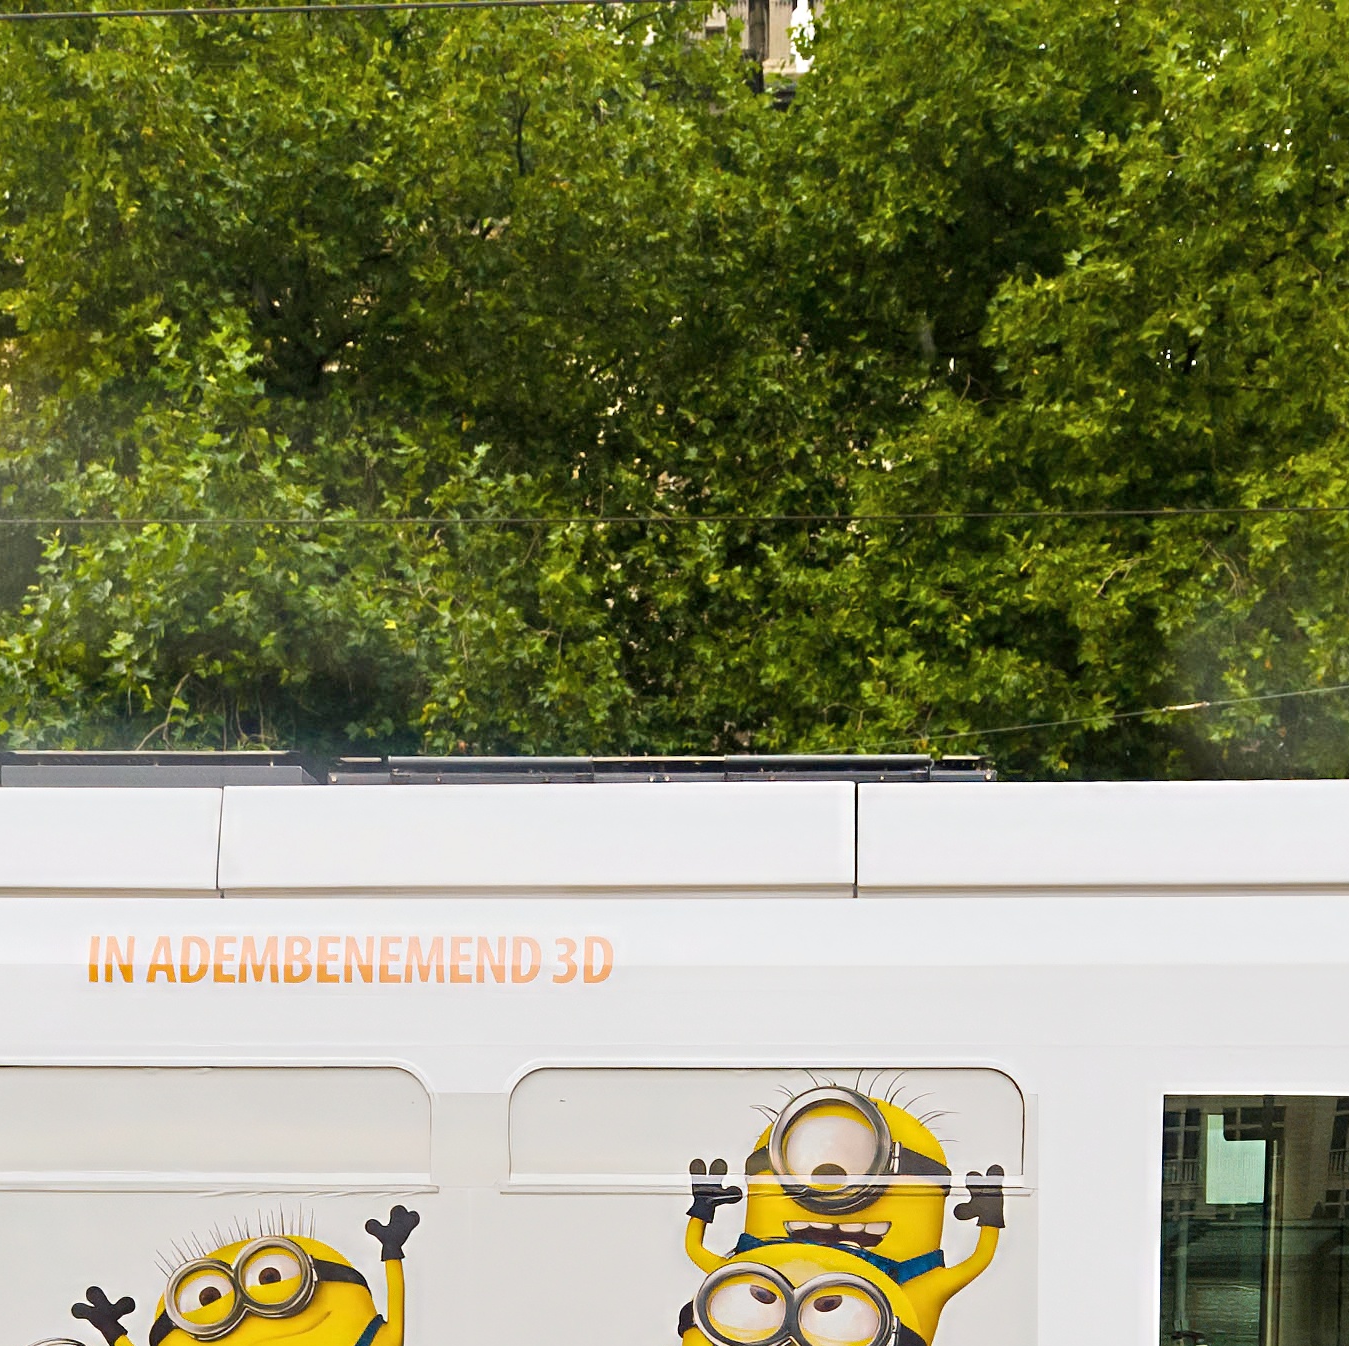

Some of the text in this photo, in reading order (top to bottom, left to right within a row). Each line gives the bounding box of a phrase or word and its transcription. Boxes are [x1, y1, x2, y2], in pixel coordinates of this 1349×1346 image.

[88, 936, 614, 984] IN ADEMBENEMEND 3D
